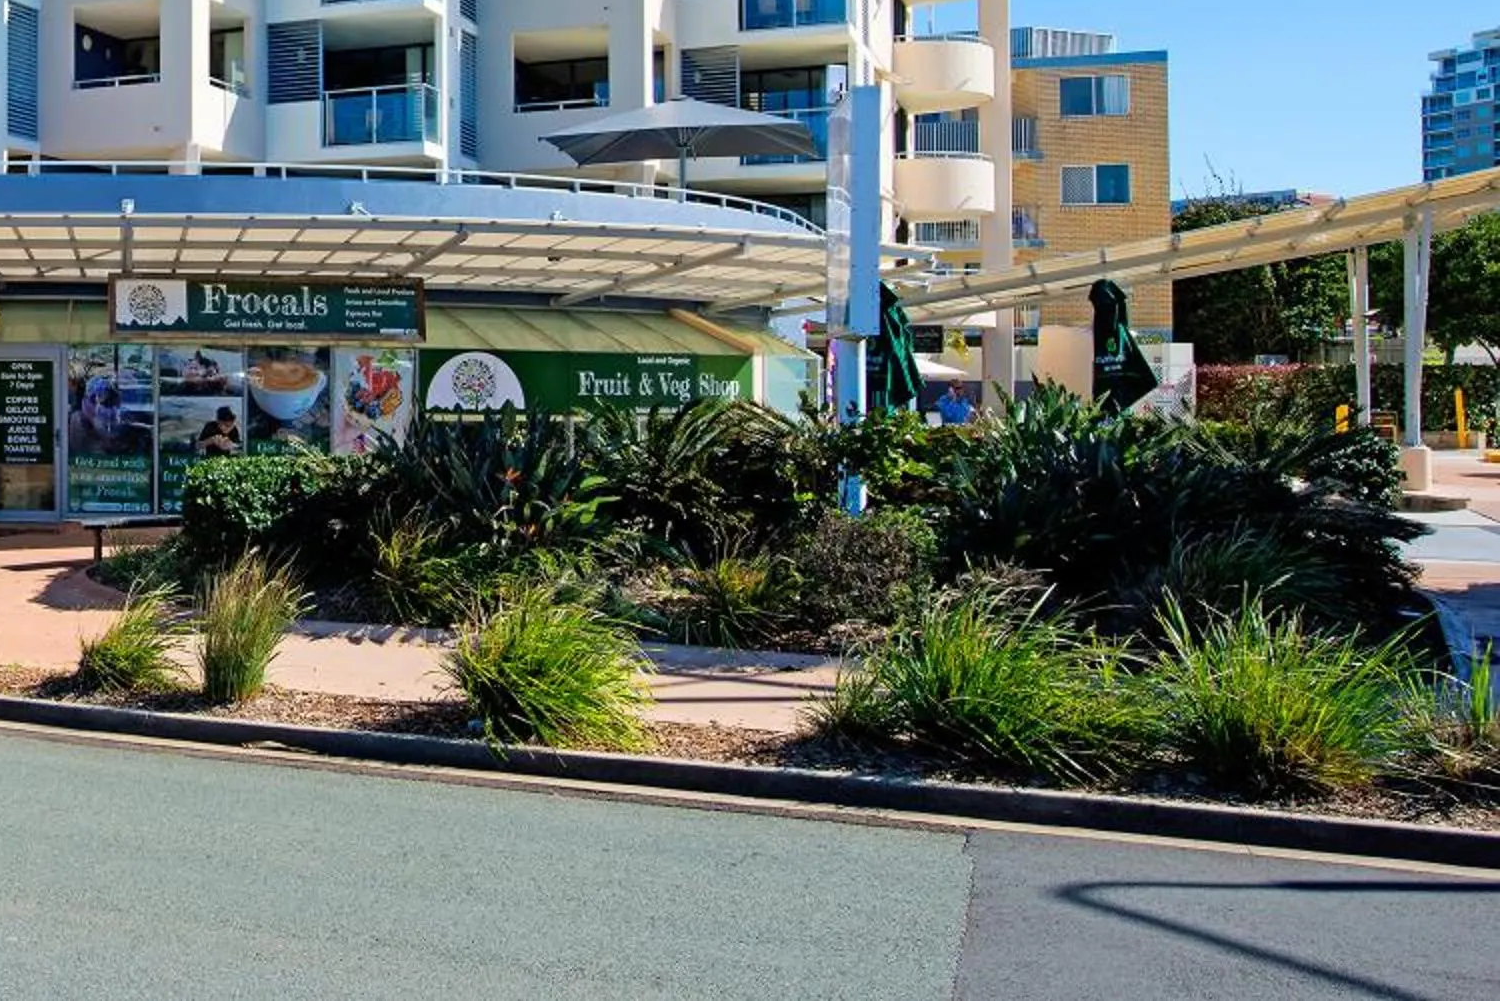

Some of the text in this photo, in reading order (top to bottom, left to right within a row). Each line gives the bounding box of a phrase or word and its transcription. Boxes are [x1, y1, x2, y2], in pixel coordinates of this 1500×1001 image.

[201, 284, 328, 316] Frocals
[16, 381, 35, 390] Days
[577, 371, 741, 403] Fruit & Veg Shop
[6, 396, 38, 404] COFFEE
[6, 406, 39, 414] GELATO
[7, 436, 37, 444] BOWLS
